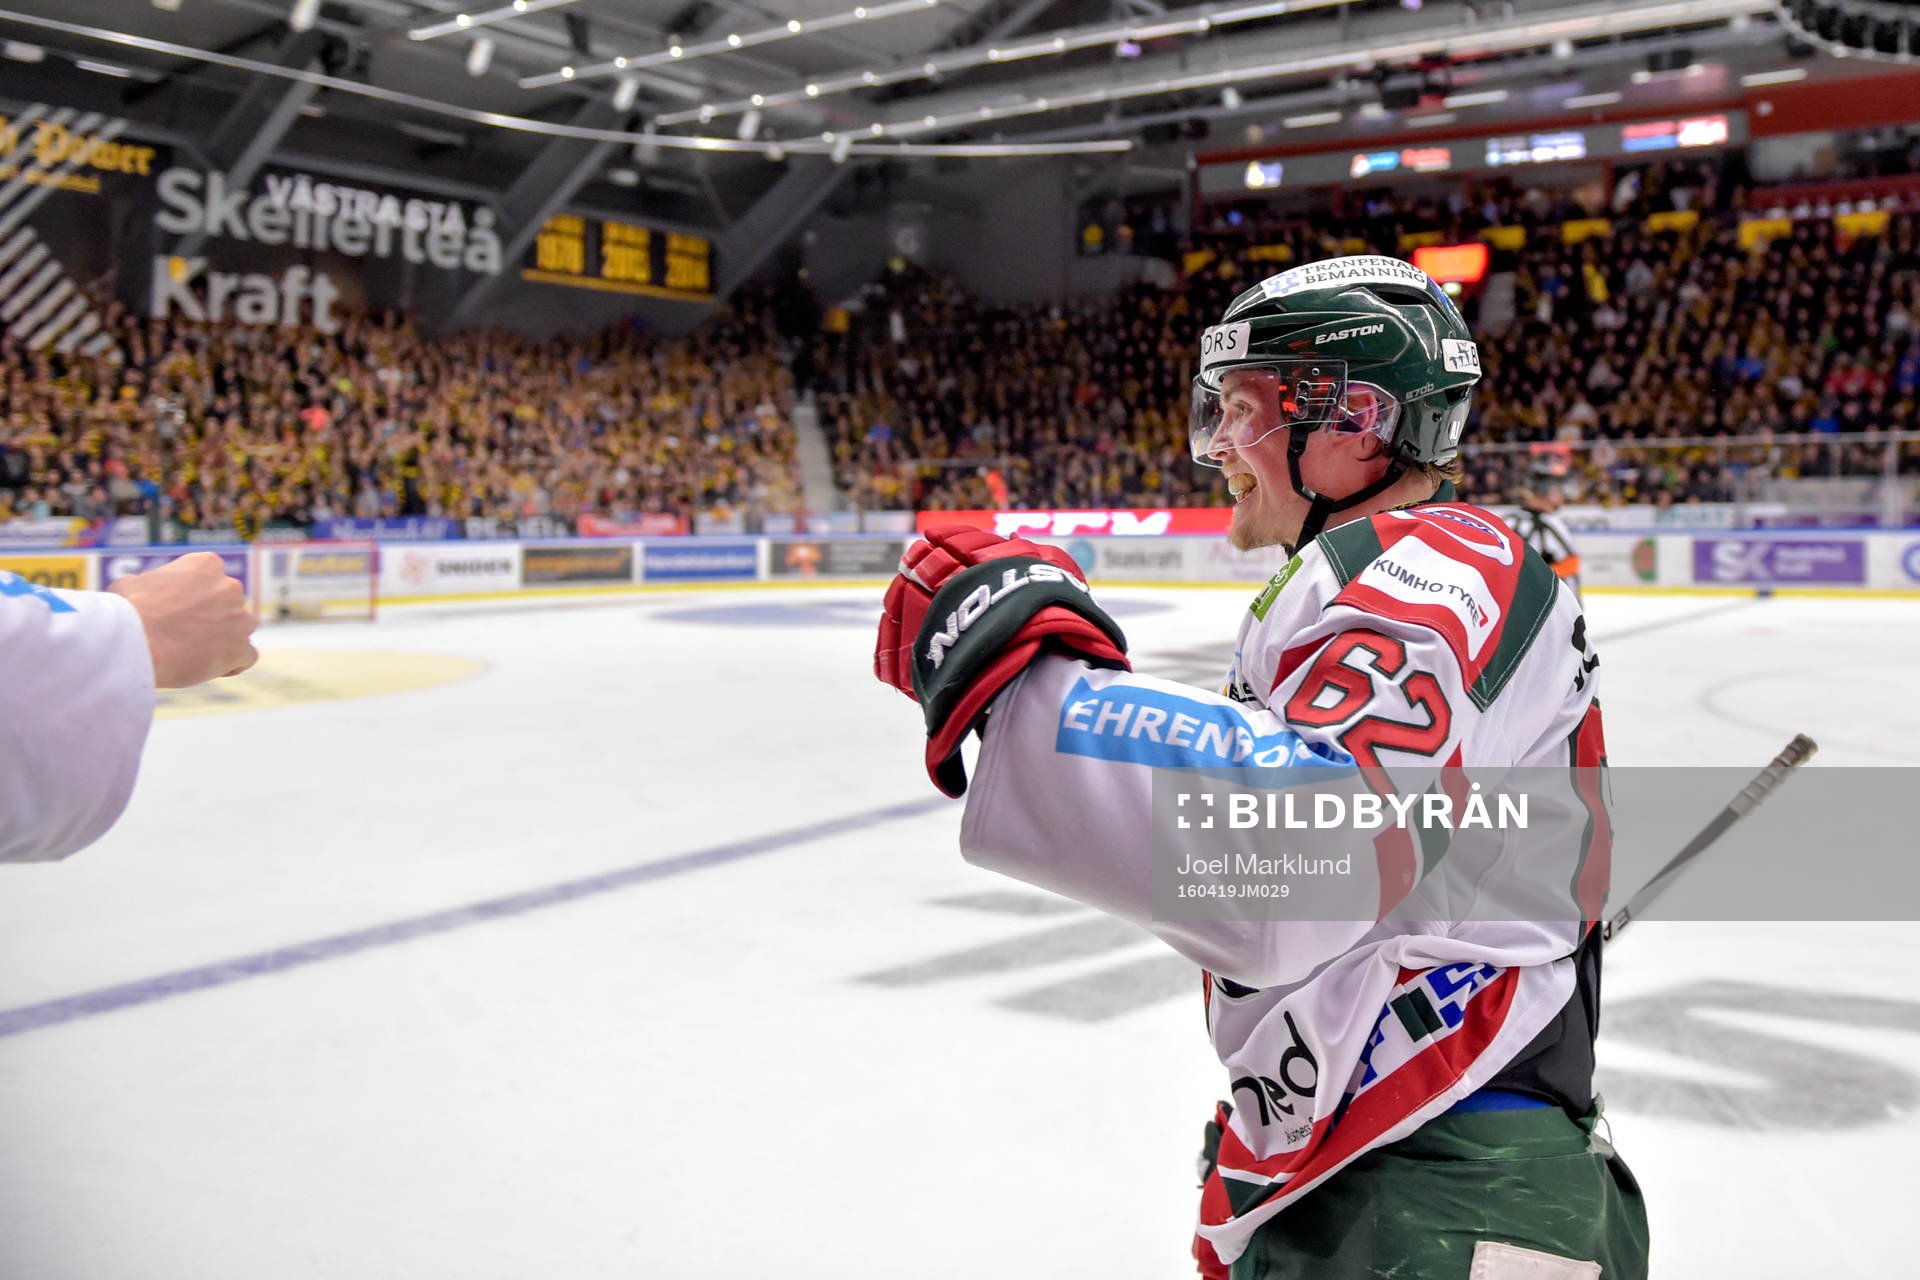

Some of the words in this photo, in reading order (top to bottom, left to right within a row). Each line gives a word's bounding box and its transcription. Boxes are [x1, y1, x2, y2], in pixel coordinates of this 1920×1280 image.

[151, 255, 342, 335] Kraft
[1302, 267, 1425, 285] BEMANNING
[1315, 323, 1384, 345] EASTON
[1373, 559, 1444, 593] KUMHO
[1448, 584, 1480, 628] TYRE
[1284, 627, 1453, 797] 62
